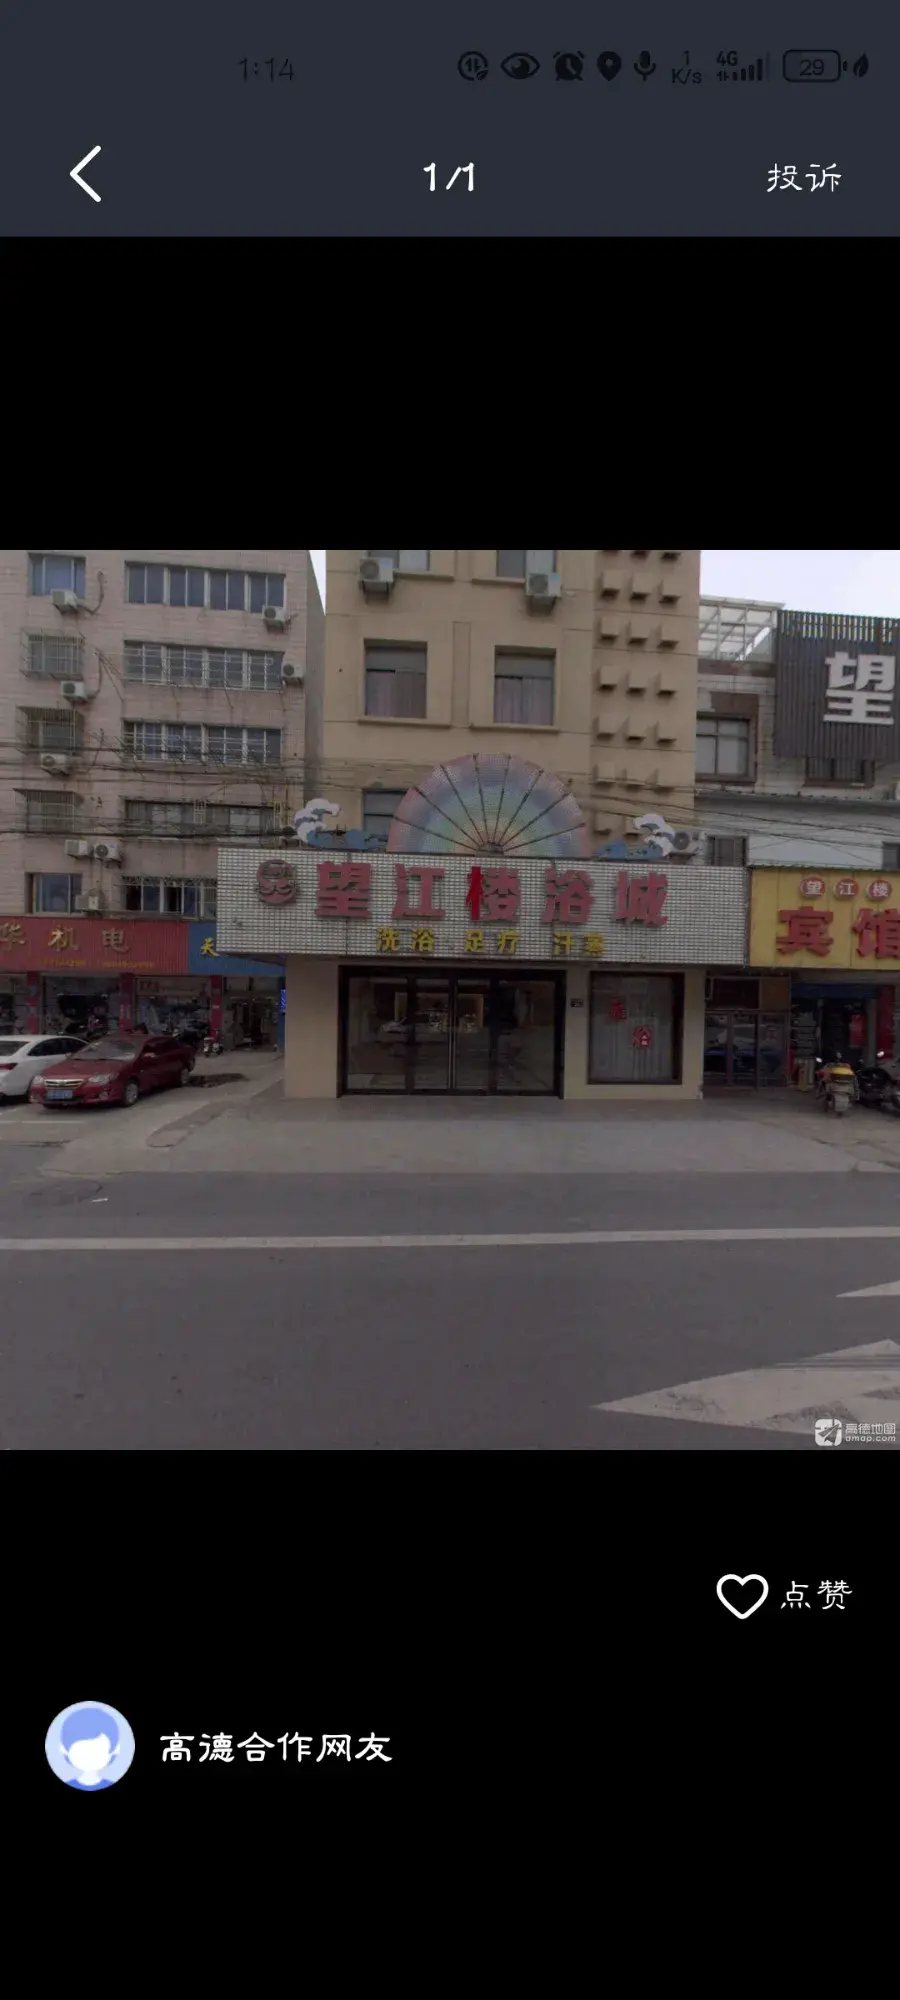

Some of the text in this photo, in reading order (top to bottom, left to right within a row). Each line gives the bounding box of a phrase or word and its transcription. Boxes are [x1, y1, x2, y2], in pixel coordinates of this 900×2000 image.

[823, 651, 896, 725] 望
[314, 860, 669, 927] 望江楼浴城
[803, 877, 891, 900] 望江楼
[375, 927, 435, 952] 洗浴
[464, 929, 521, 955] 足疗
[776, 906, 900, 959] 宾馆
